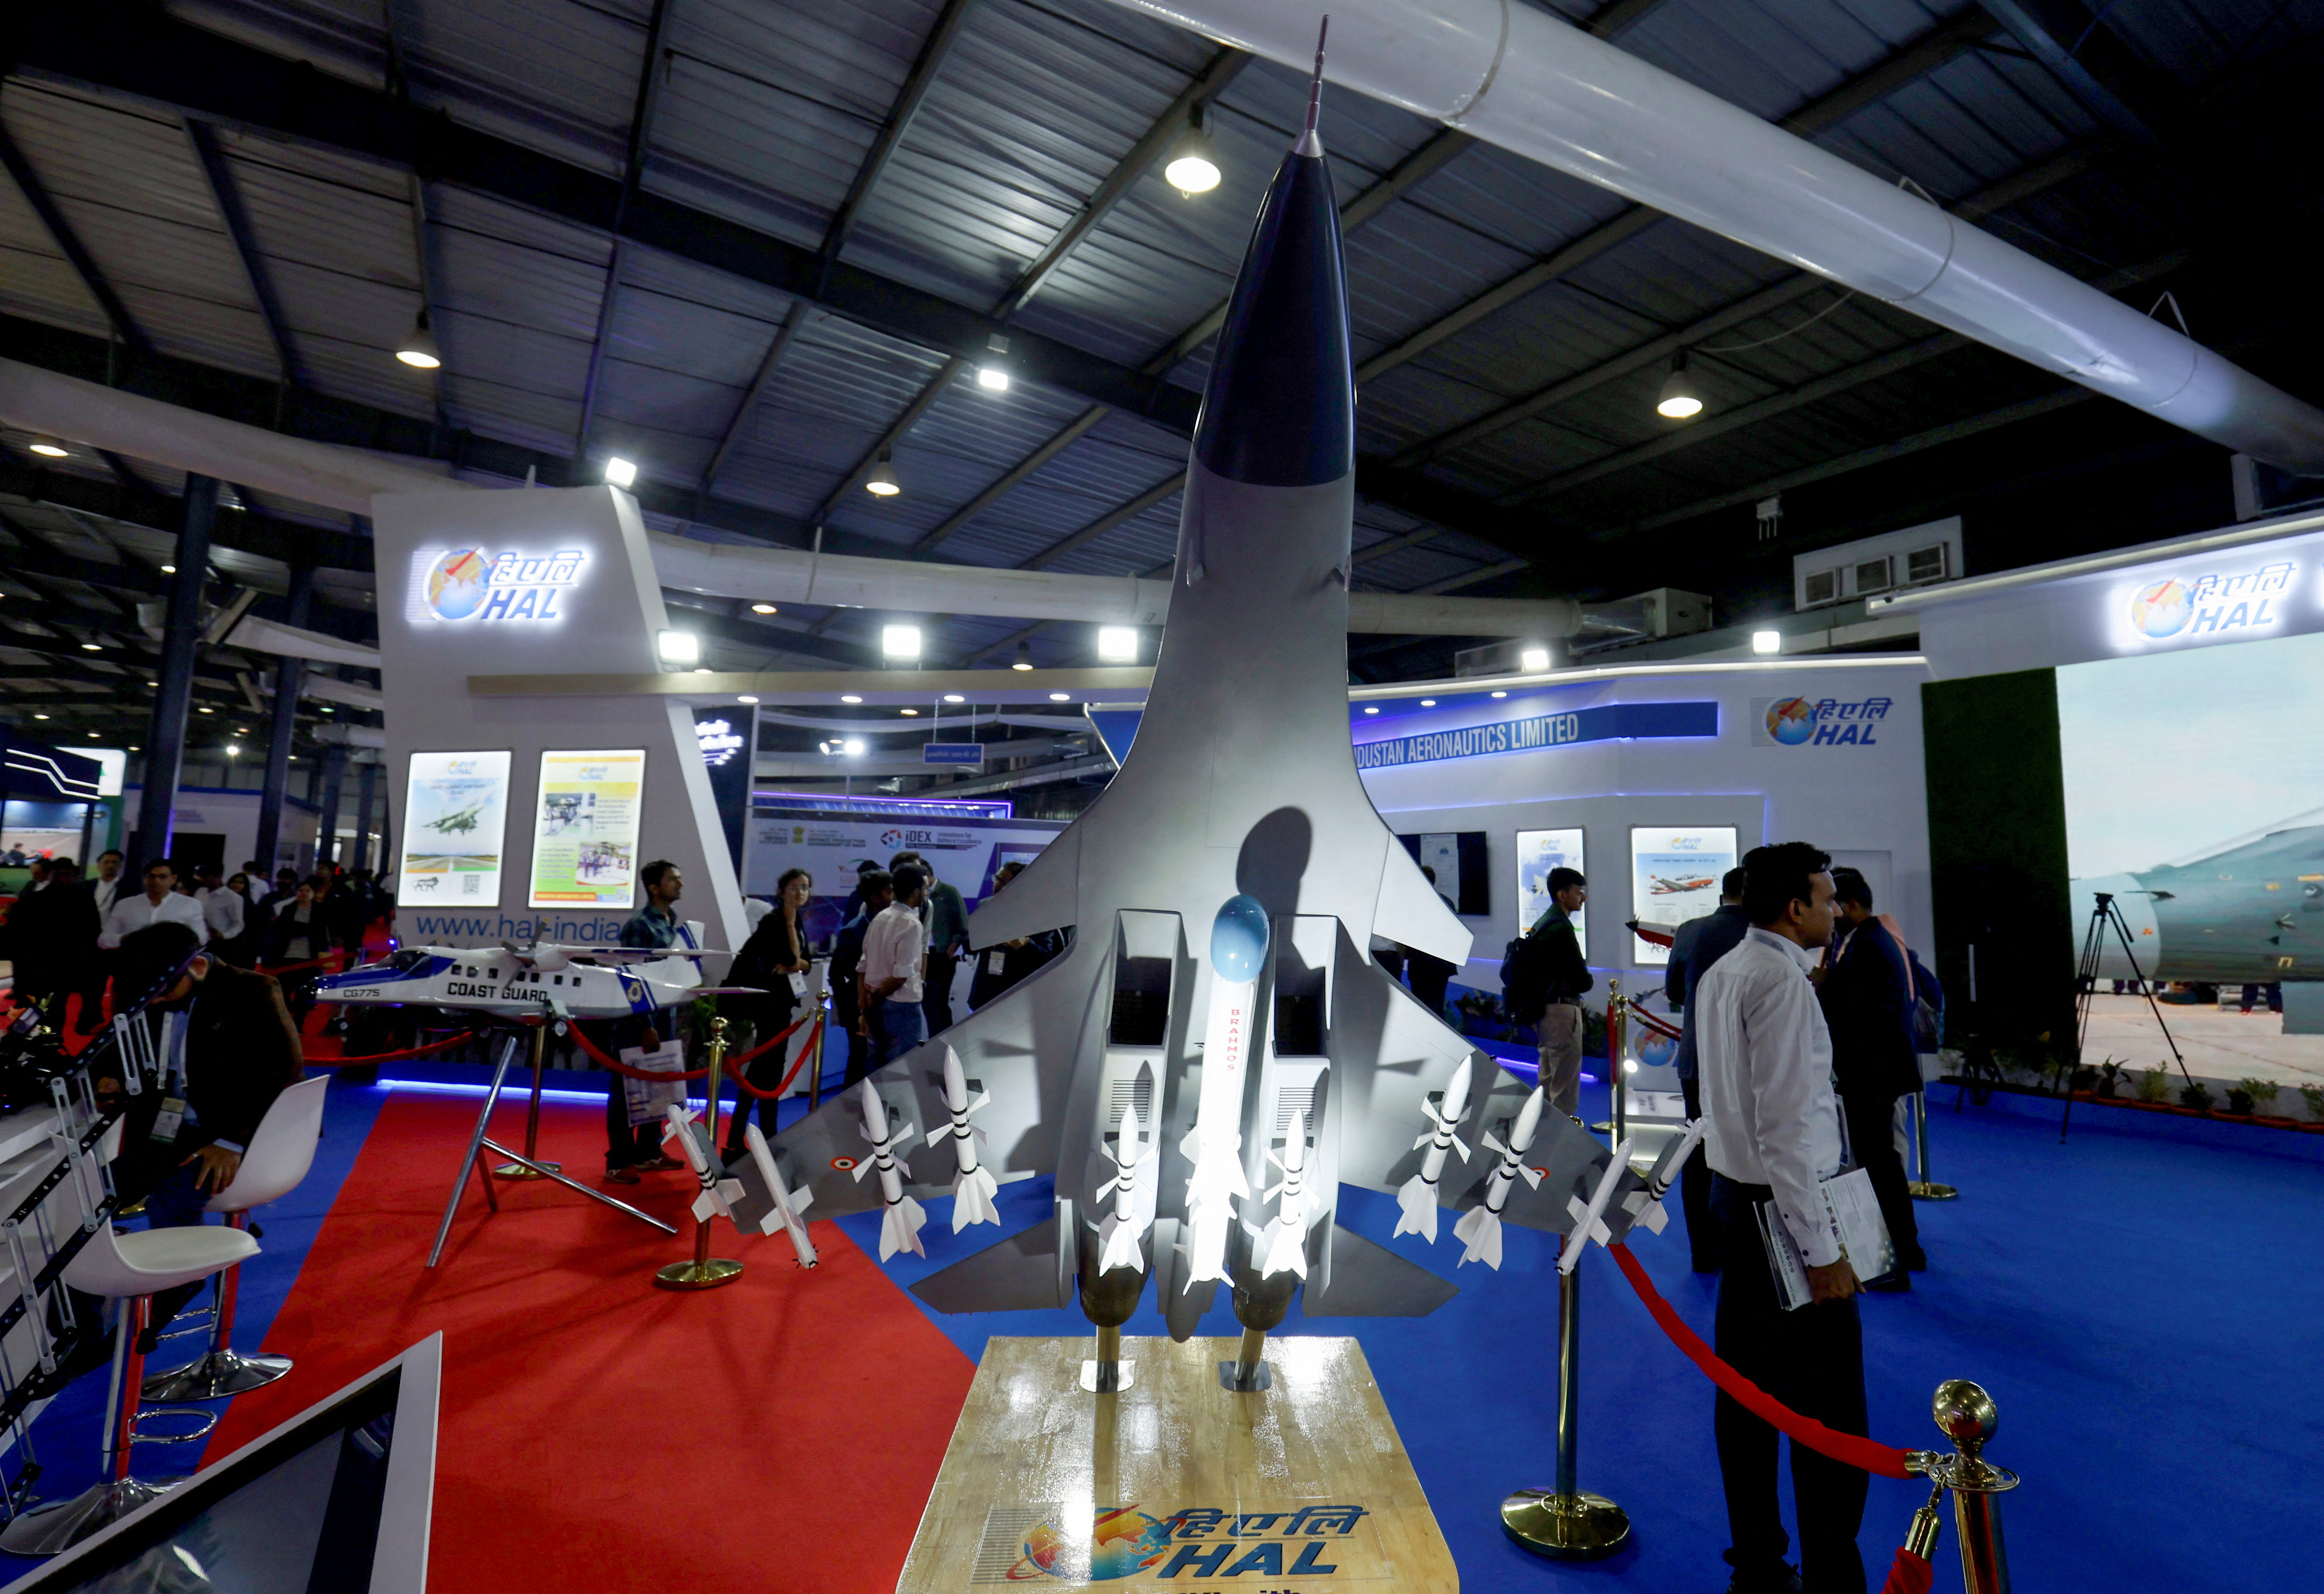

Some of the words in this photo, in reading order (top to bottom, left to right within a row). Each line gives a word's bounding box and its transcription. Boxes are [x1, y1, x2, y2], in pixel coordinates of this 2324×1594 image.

[481, 589, 557, 619] HAL
[2191, 599, 2275, 634] HAL
[1407, 724, 1506, 763] AERONAUTICS
[1511, 713, 1578, 749] LIMITED
[1813, 724, 1877, 745] HAL
[905, 830, 932, 842] iDEX
[447, 982, 497, 998] COAST
[501, 987, 547, 1002] GUARD
[1226, 1008, 1241, 1071] BRAHMOS
[1157, 1541, 1339, 1578] HAL
